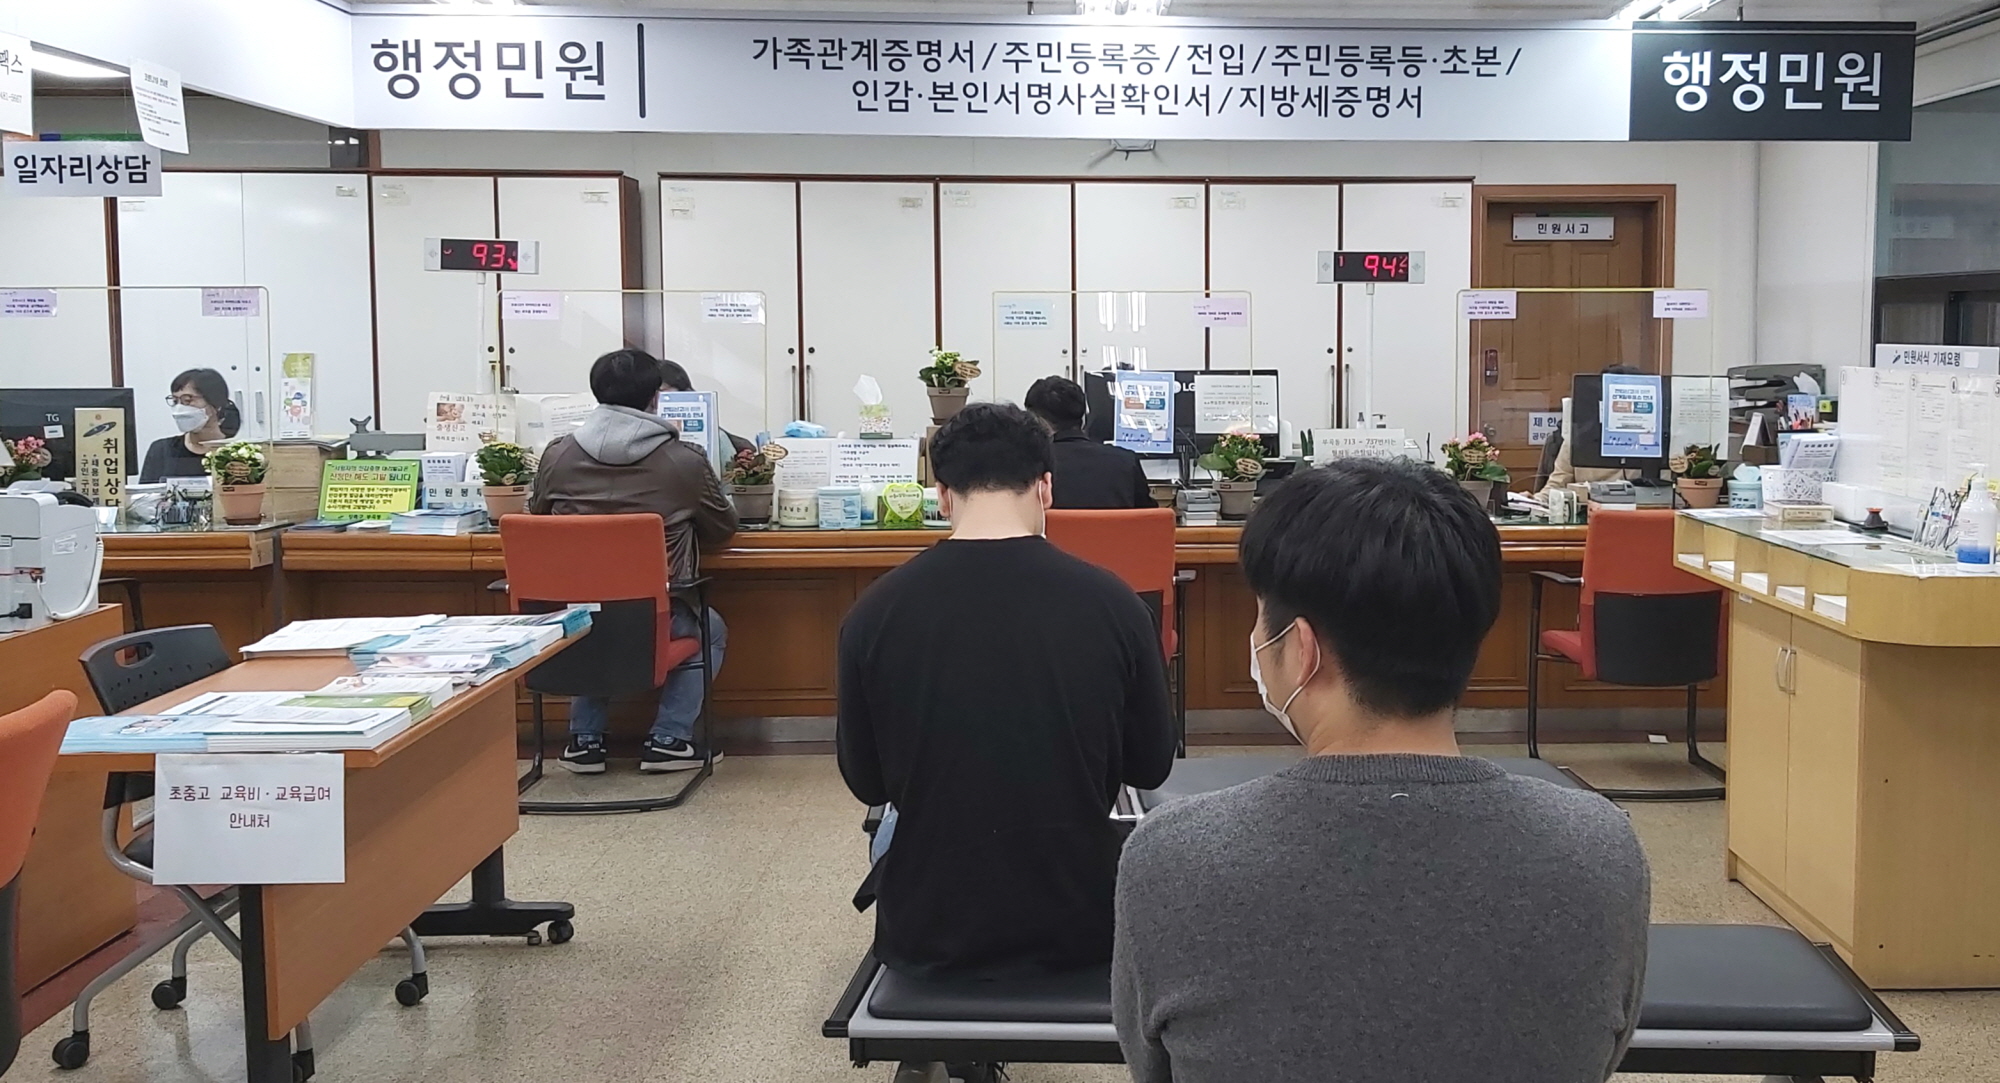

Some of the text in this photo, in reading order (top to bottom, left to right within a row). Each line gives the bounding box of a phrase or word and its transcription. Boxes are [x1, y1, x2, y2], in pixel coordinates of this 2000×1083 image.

[371, 38, 606, 101] 행정민원
[1662, 49, 1882, 113] 행정민원
[14, 154, 151, 185] 일자리상담
[1537, 223, 1589, 235] 민원서고
[1904, 350, 1961, 367] 민원서식 기재요령
[45, 413, 60, 422] TG
[1532, 432, 1551, 441] 공무
[169, 785, 211, 802] 초중고
[229, 812, 271, 829] 안내처
